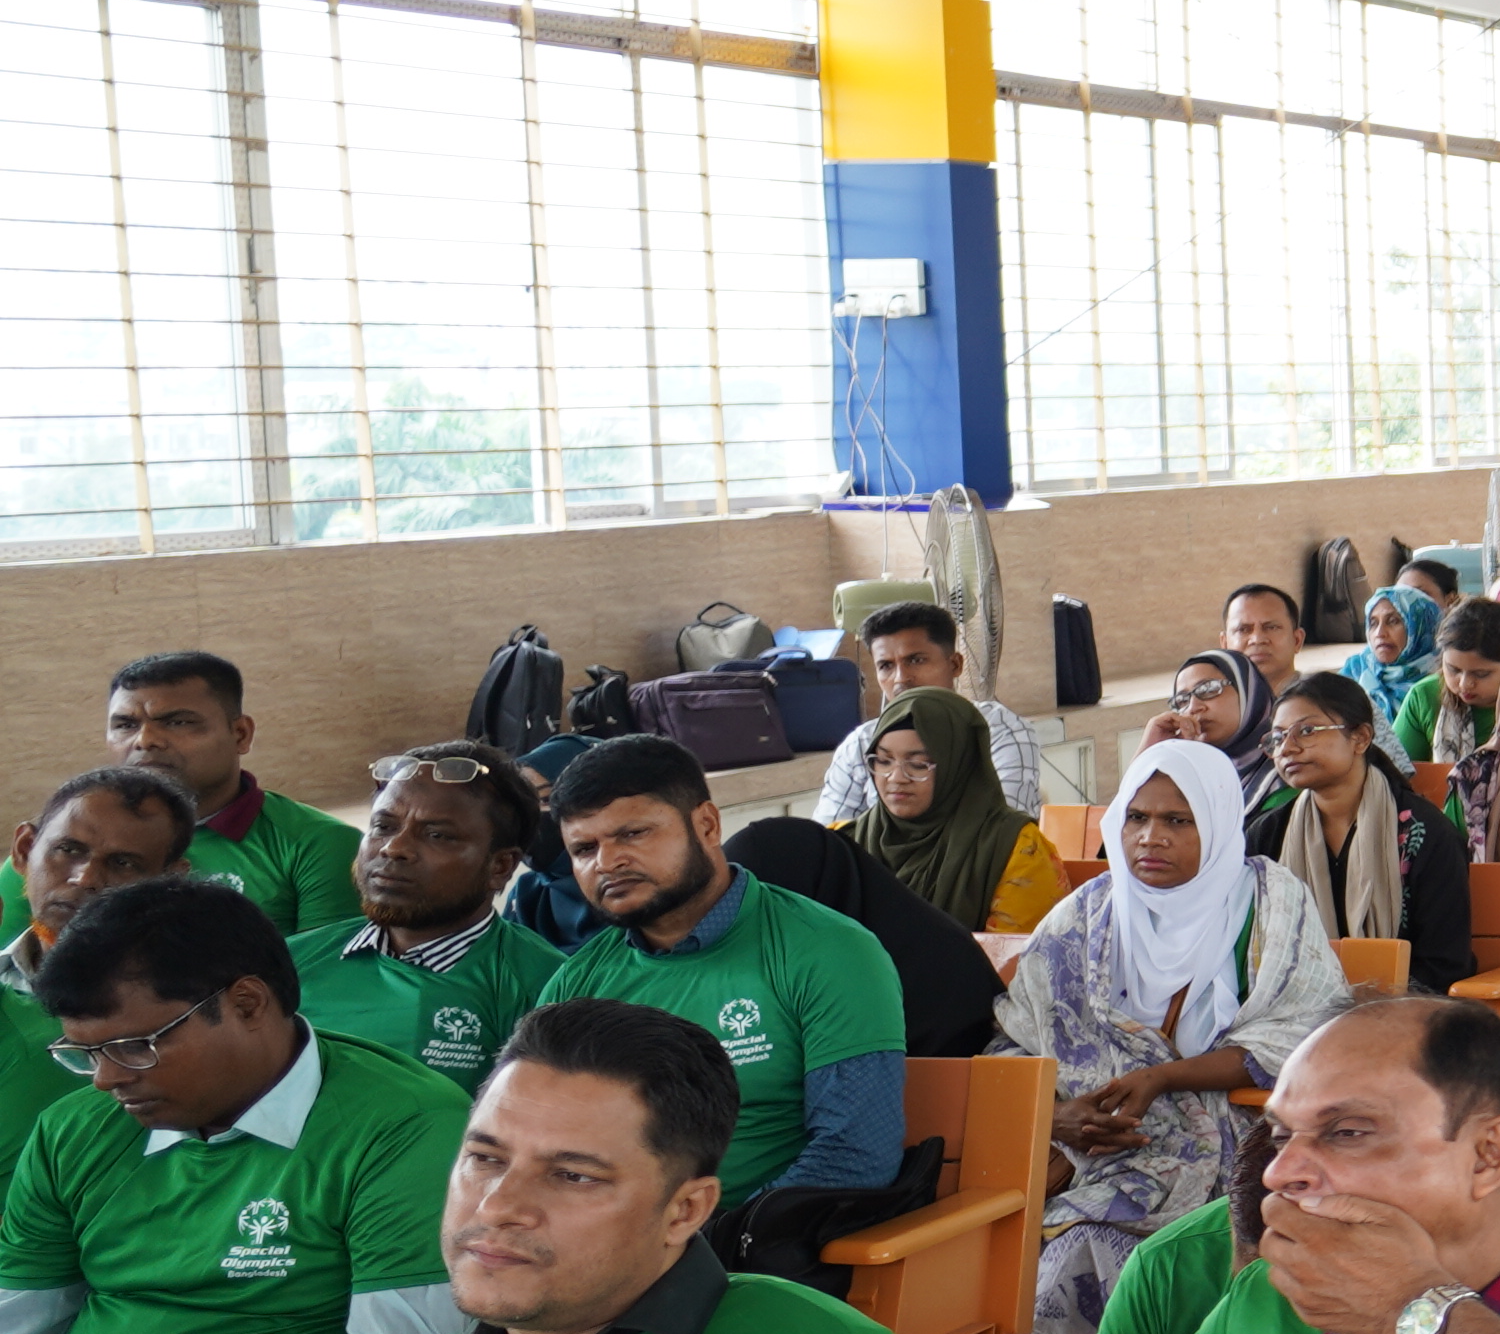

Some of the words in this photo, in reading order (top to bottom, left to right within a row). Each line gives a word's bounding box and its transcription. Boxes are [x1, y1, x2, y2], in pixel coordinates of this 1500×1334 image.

[428, 1039, 483, 1052] Special
[421, 1047, 487, 1062] Olympics
[229, 1245, 291, 1257] Special
[220, 1257, 297, 1270] Olympics
[228, 1268, 288, 1279] Bangladesh
